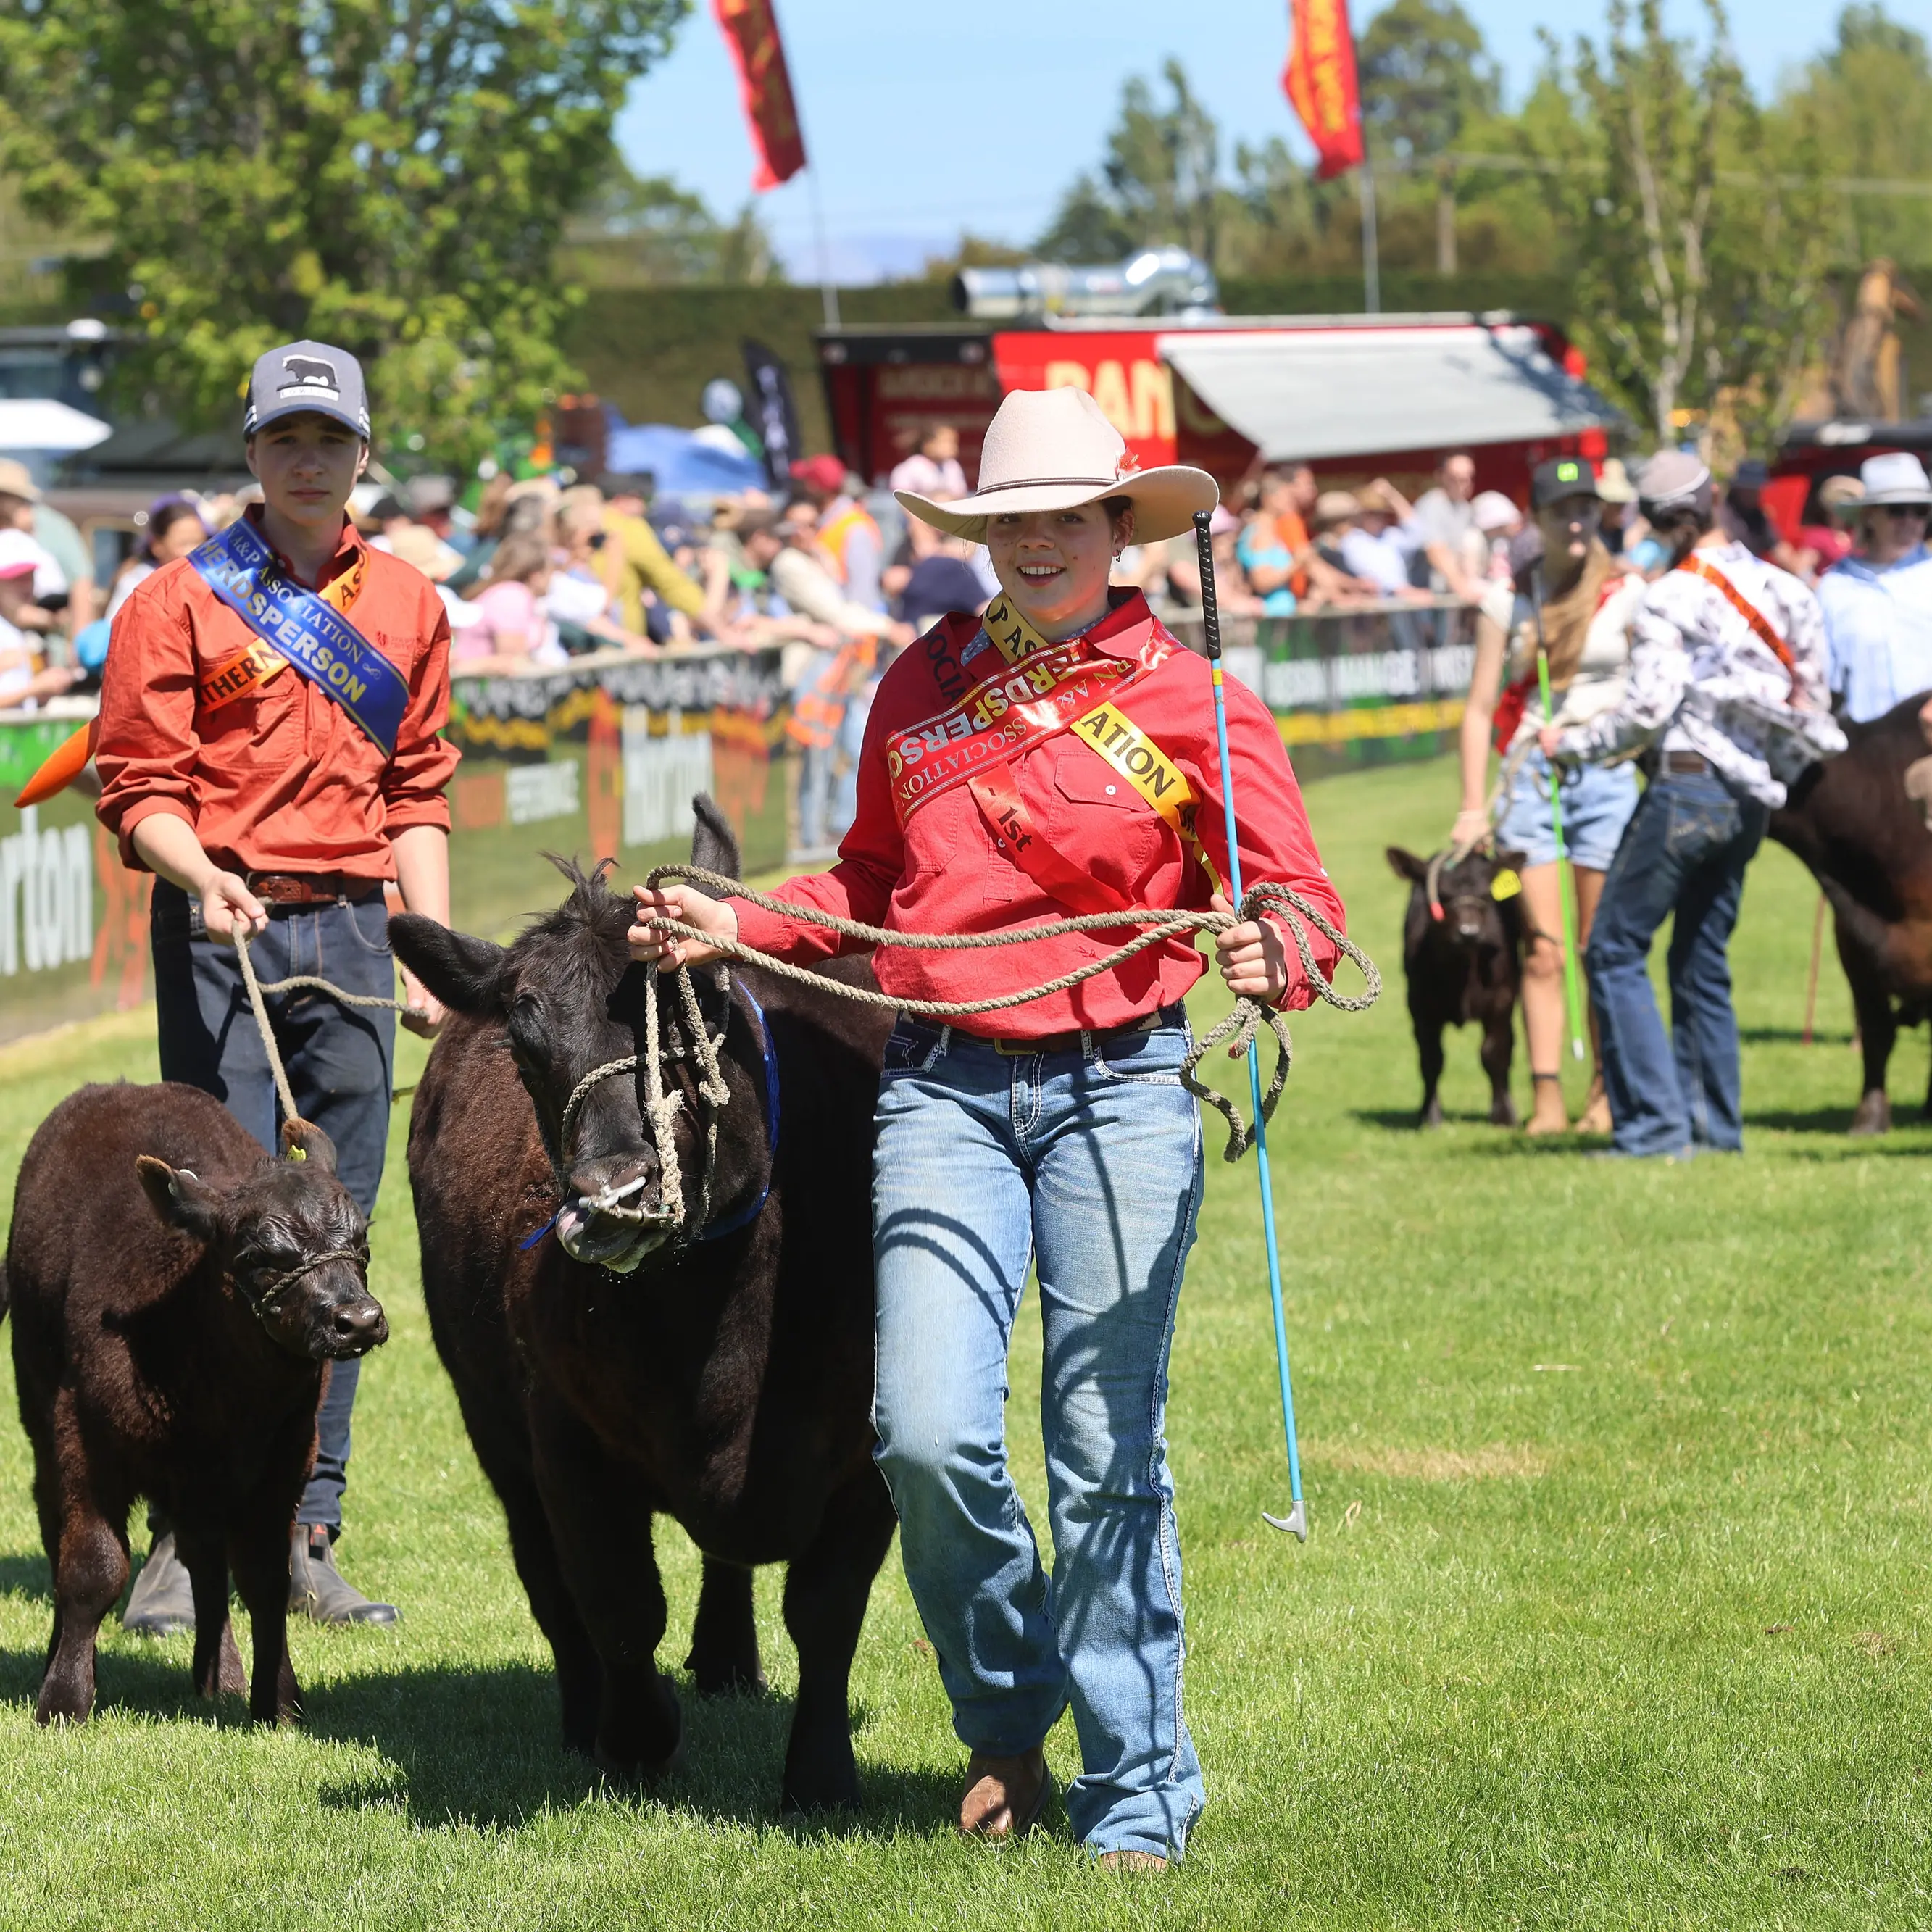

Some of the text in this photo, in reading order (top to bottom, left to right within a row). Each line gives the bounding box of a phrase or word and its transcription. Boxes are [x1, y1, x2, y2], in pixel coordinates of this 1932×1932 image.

[198, 538, 367, 704] HERDSPERSON
[256, 565, 363, 665] ASSOCIATION
[200, 644, 281, 707] THERN
[887, 647, 1080, 780] ERDSPERSO
[923, 630, 966, 707] OCIA
[1056, 679, 1089, 708] A&
[898, 715, 1029, 807] SSOCIATION
[1083, 711, 1176, 799] ATION
